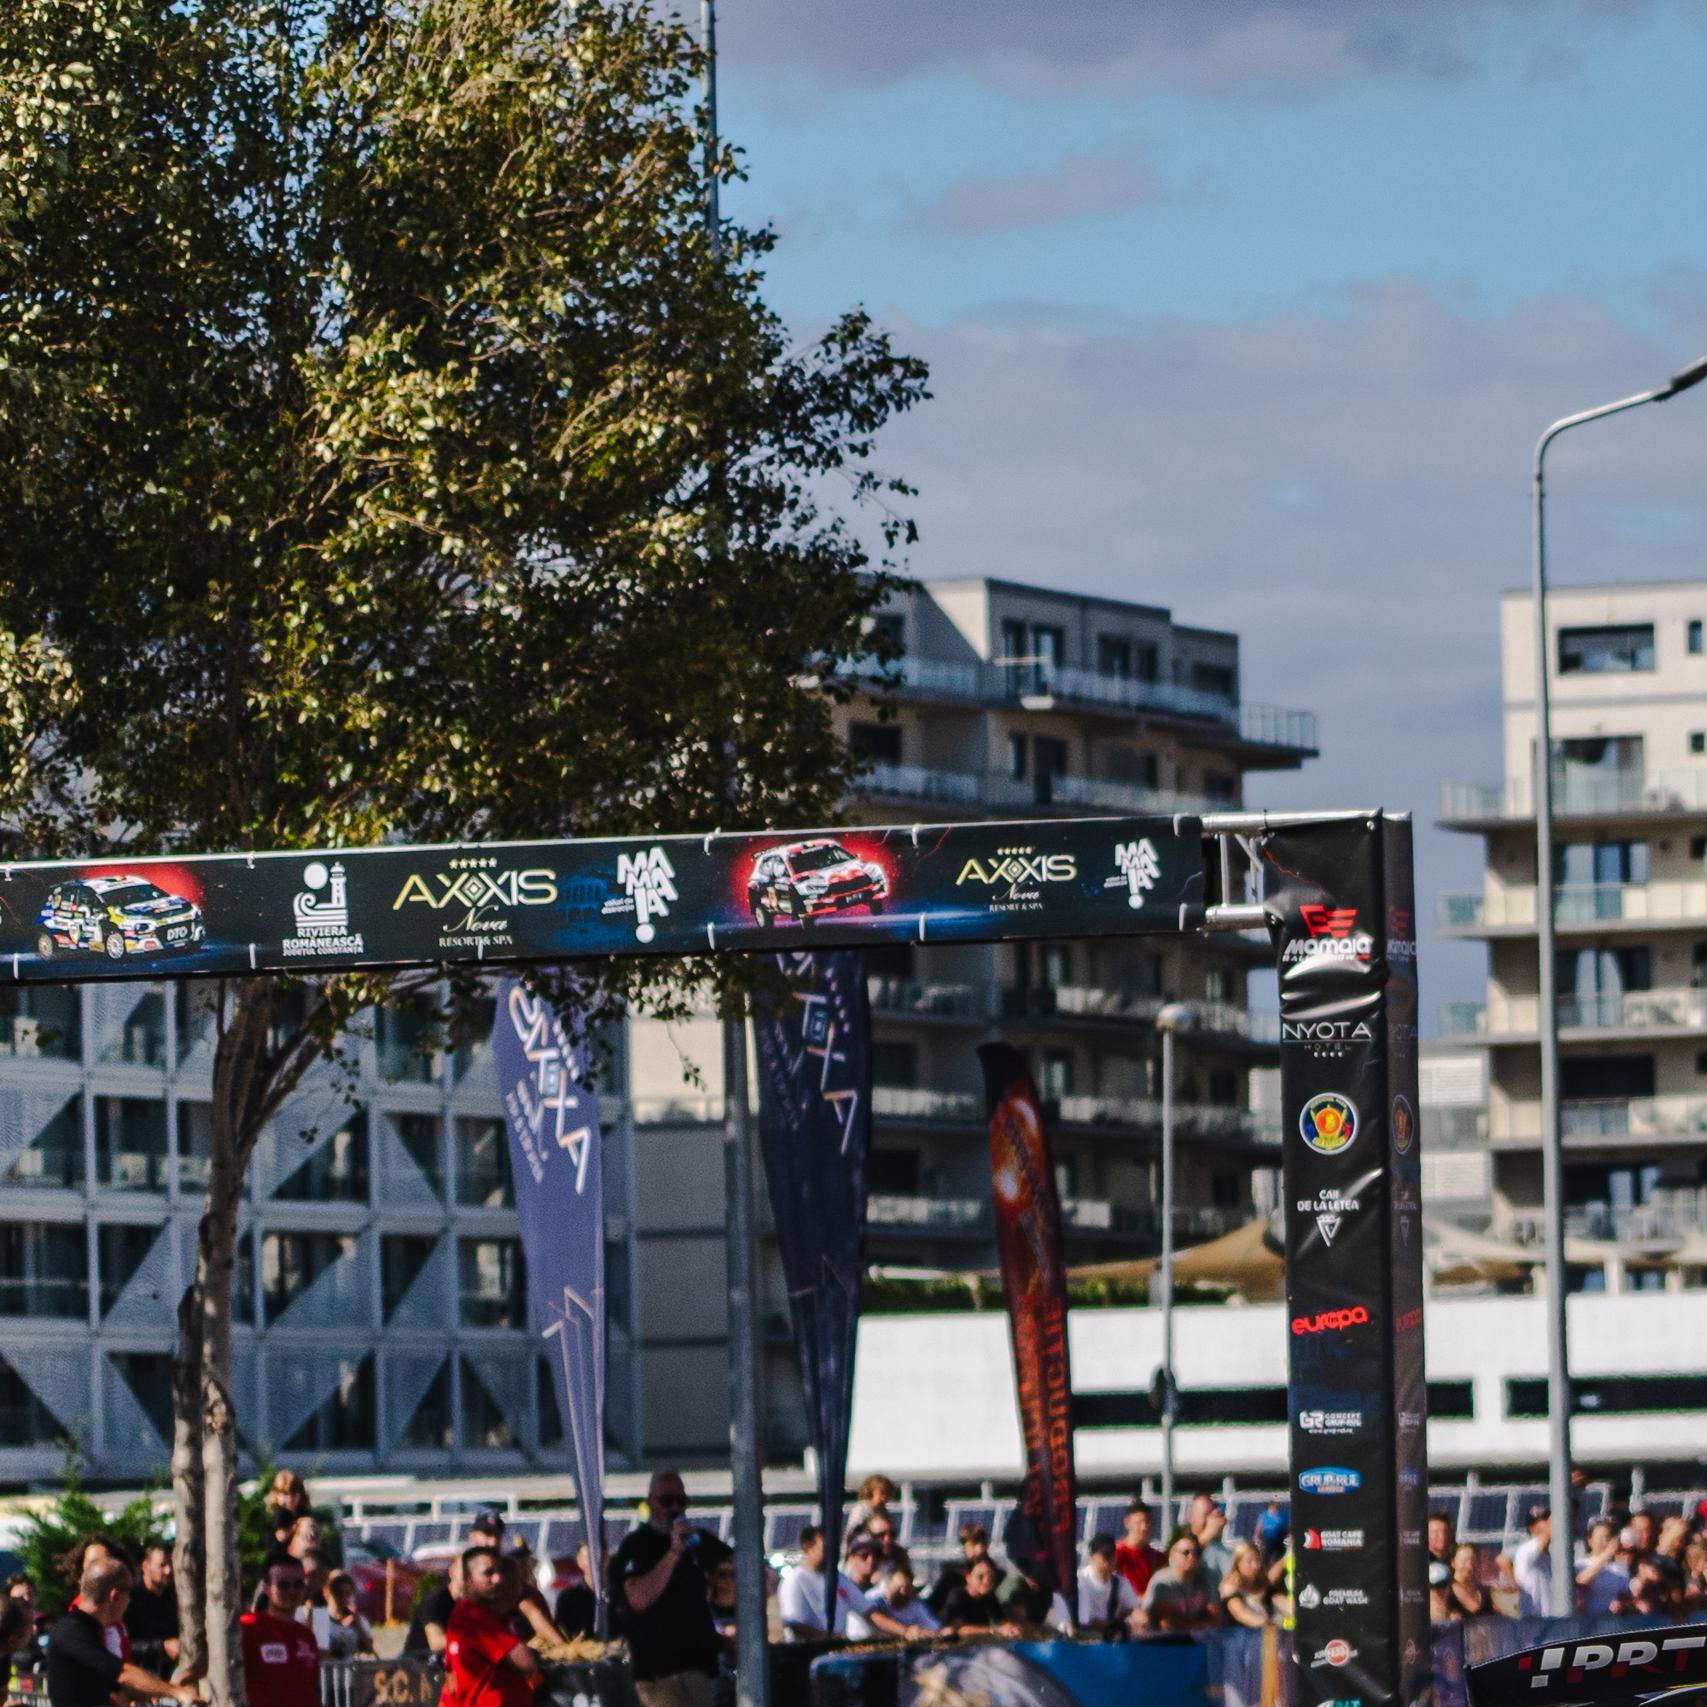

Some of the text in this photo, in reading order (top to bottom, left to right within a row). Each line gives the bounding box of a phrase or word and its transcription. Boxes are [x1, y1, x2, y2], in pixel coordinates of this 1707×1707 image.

[296, 926, 348, 939] RIVIERA
[1282, 1021, 1372, 1039] NYOTA
[1292, 1306, 1368, 1335] europa
